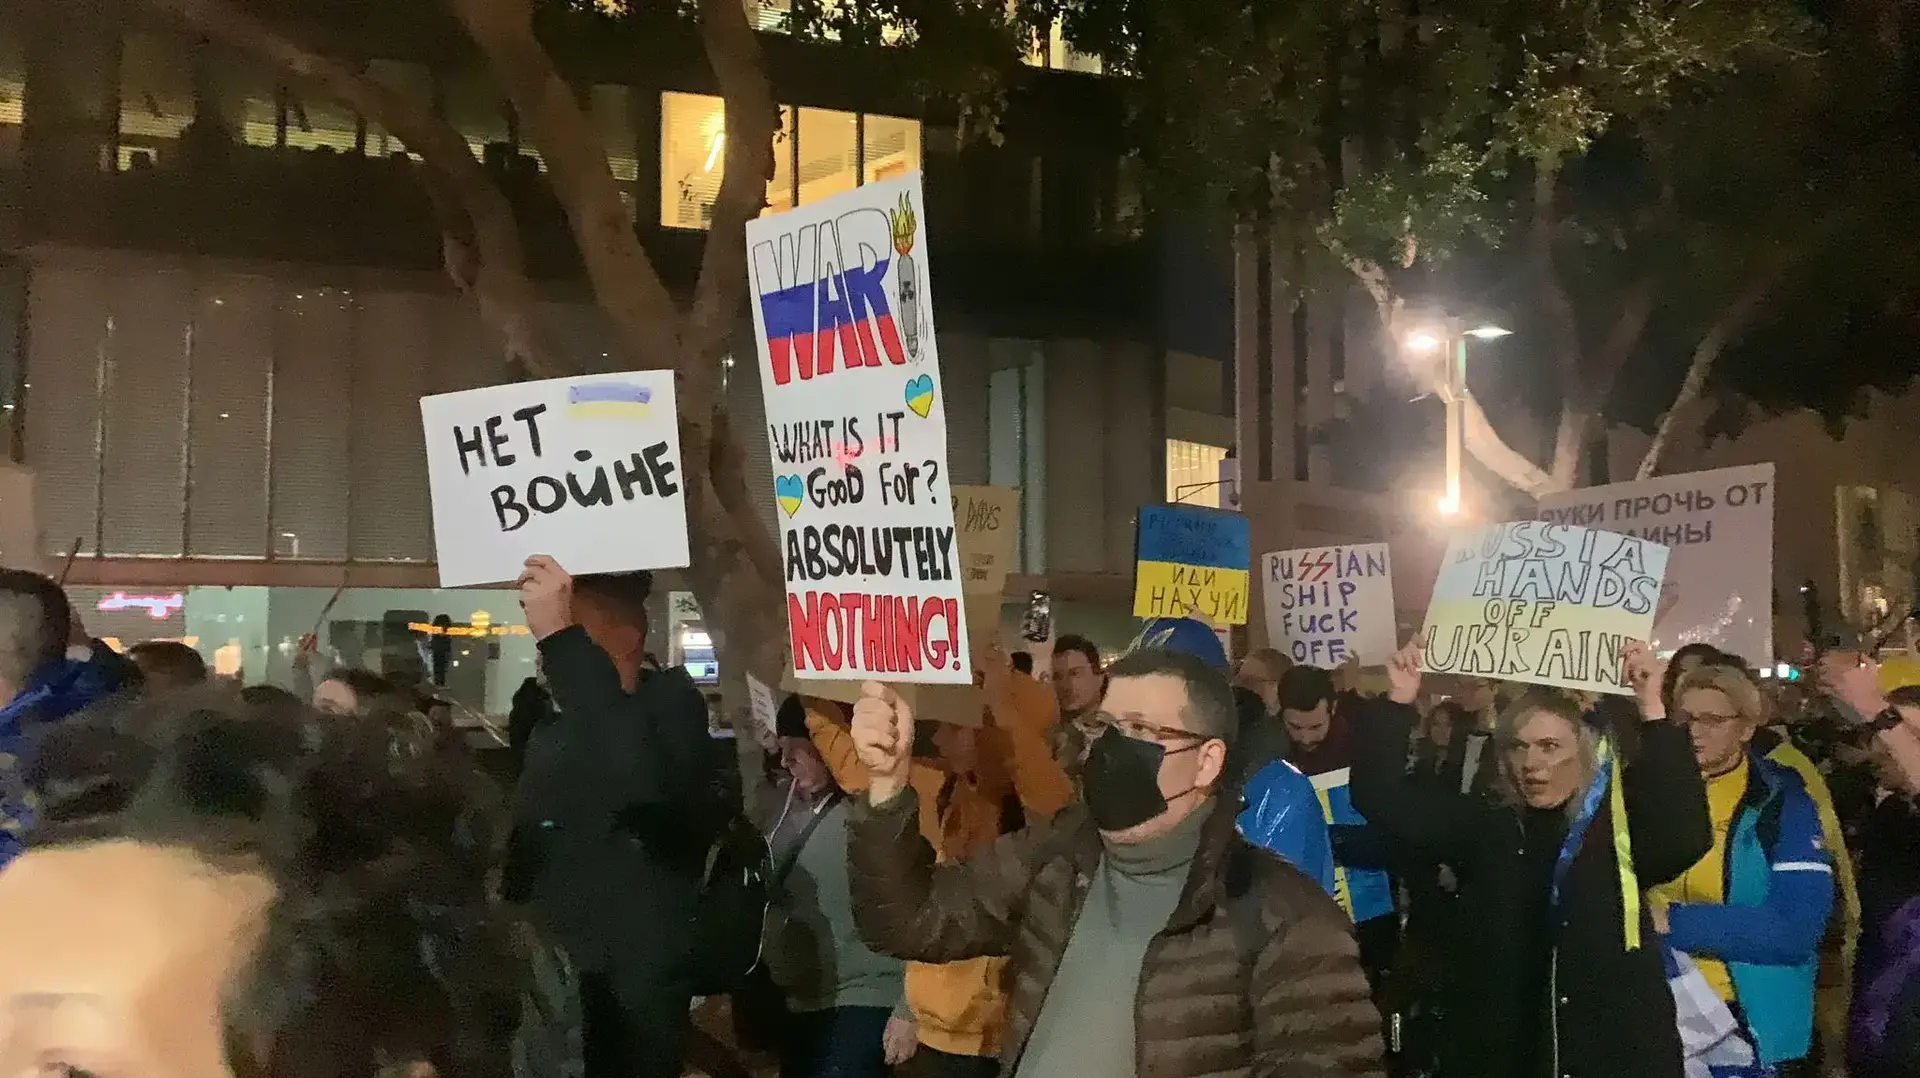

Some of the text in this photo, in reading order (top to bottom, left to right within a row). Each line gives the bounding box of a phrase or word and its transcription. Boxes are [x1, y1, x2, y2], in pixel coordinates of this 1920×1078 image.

[753, 207, 906, 386] WAR
[453, 403, 547, 476] НЕТ
[771, 411, 905, 463] WHAT IS IT
[490, 441, 678, 532] ВОЙНЕ
[1614, 489, 1716, 521] ПРОЧЬ
[1726, 482, 1768, 507] ОТ
[787, 523, 954, 582] ABSOLUTELY
[1172, 565, 1216, 587] ИДИ
[1473, 559, 1657, 615] HANDS
[1484, 598, 1555, 628] OFF
[788, 590, 961, 673] NOTHING!
[1282, 608, 1358, 636] FUCK
[1291, 639, 1345, 663] OFF
